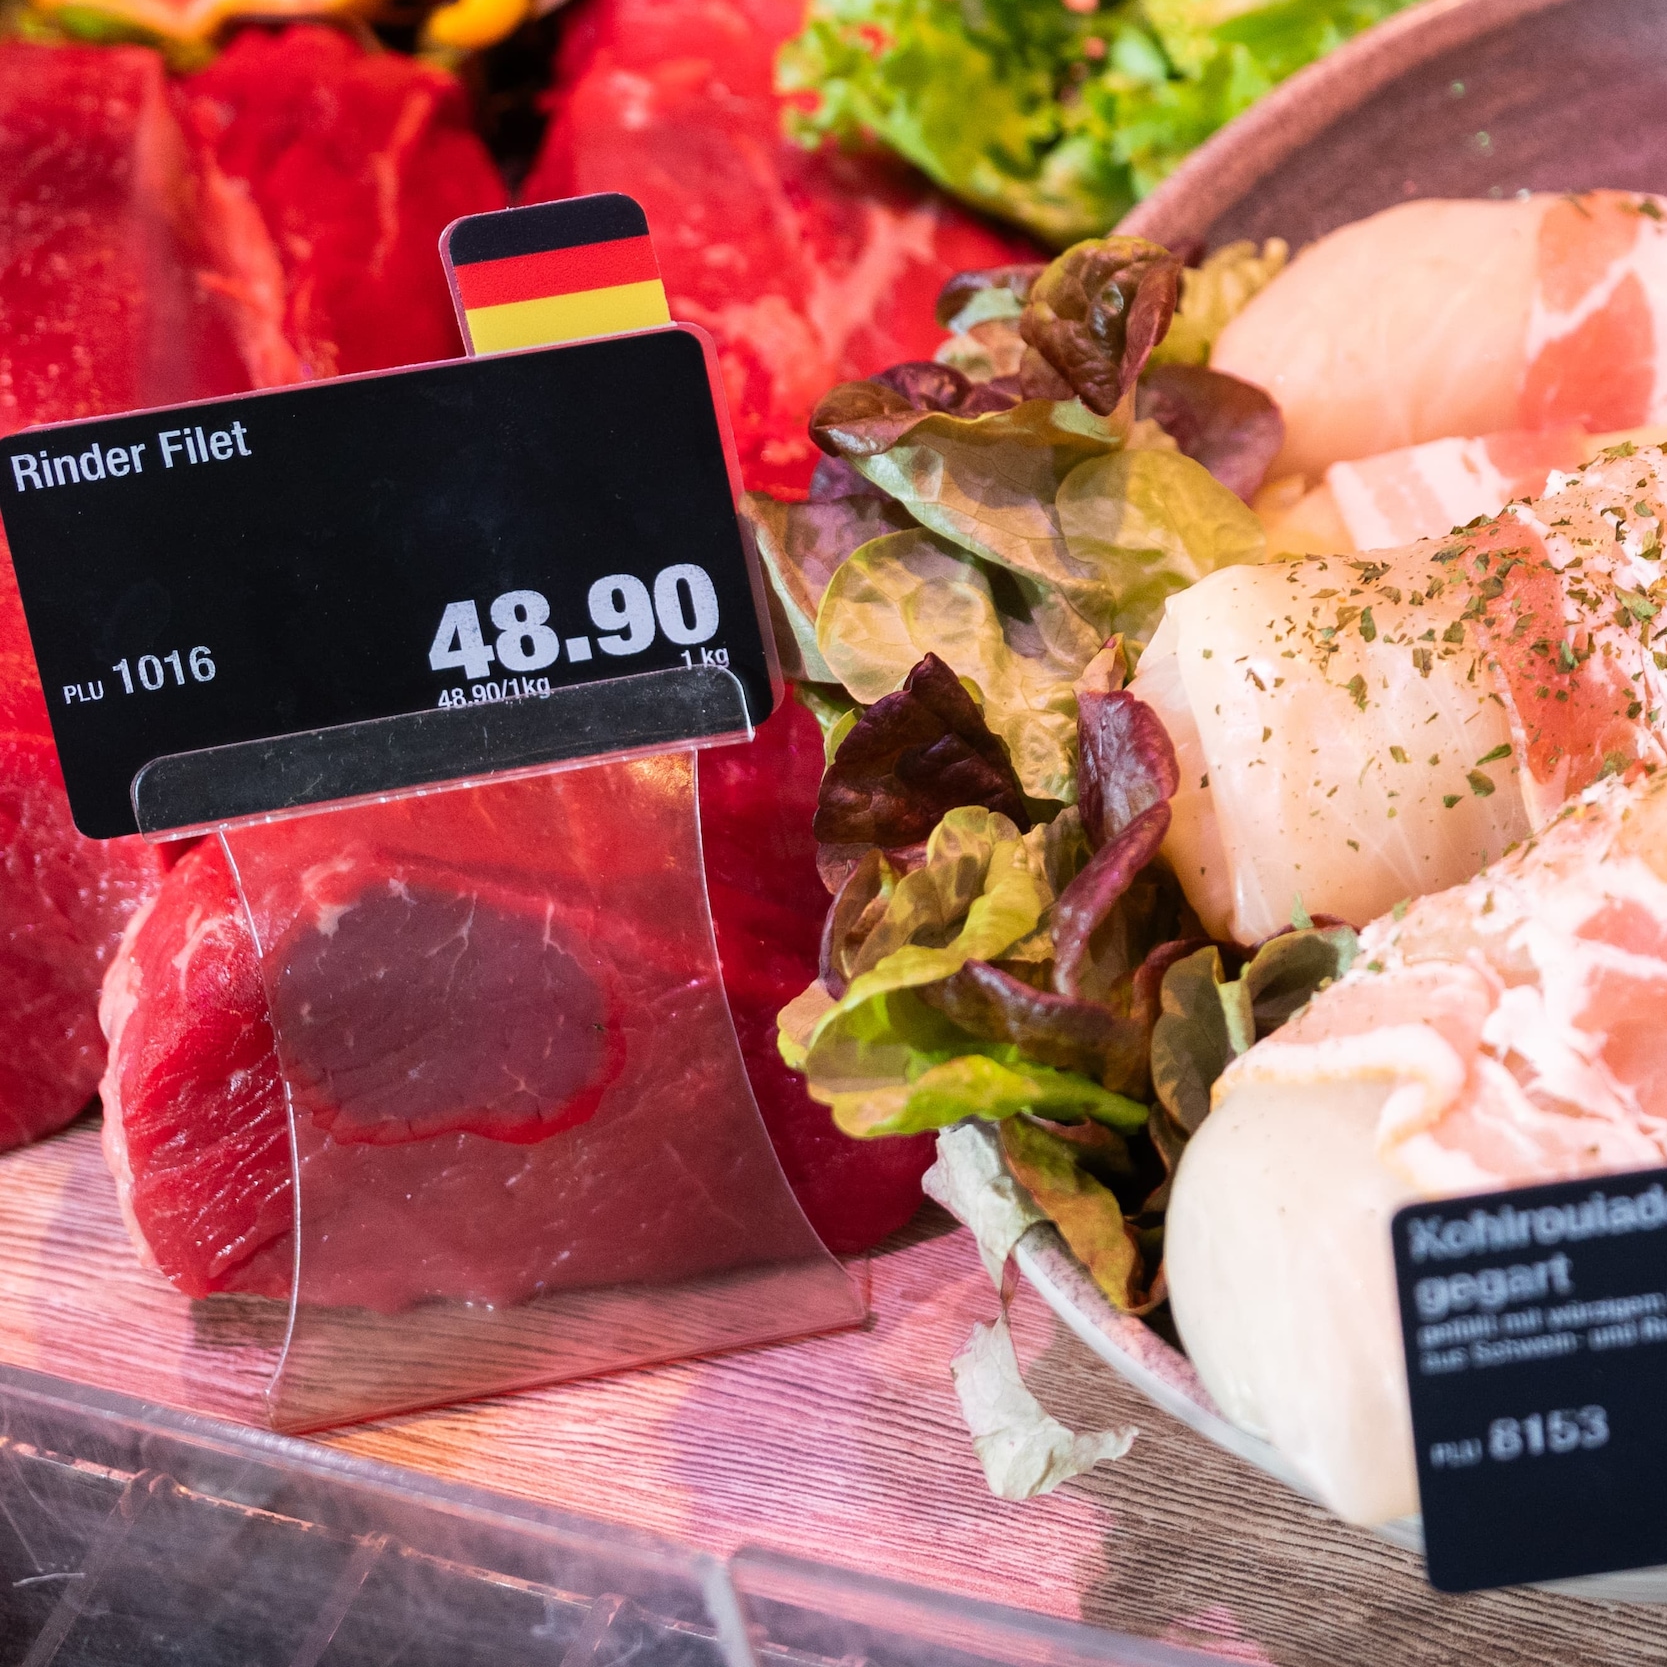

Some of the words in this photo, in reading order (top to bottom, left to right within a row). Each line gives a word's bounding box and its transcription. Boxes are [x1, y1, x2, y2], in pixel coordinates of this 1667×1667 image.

[10, 442, 146, 492] Rinder
[158, 420, 252, 469] Filet
[428, 563, 720, 680] 48.90
[63, 680, 104, 705] PLU
[112, 645, 216, 694] 1016
[681, 649, 693, 670] 1
[701, 646, 729, 669] kg
[438, 675, 551, 708] 48.90/1kg
[1414, 1252, 1573, 1323] gegart
[1488, 1404, 1610, 1461] 8153
